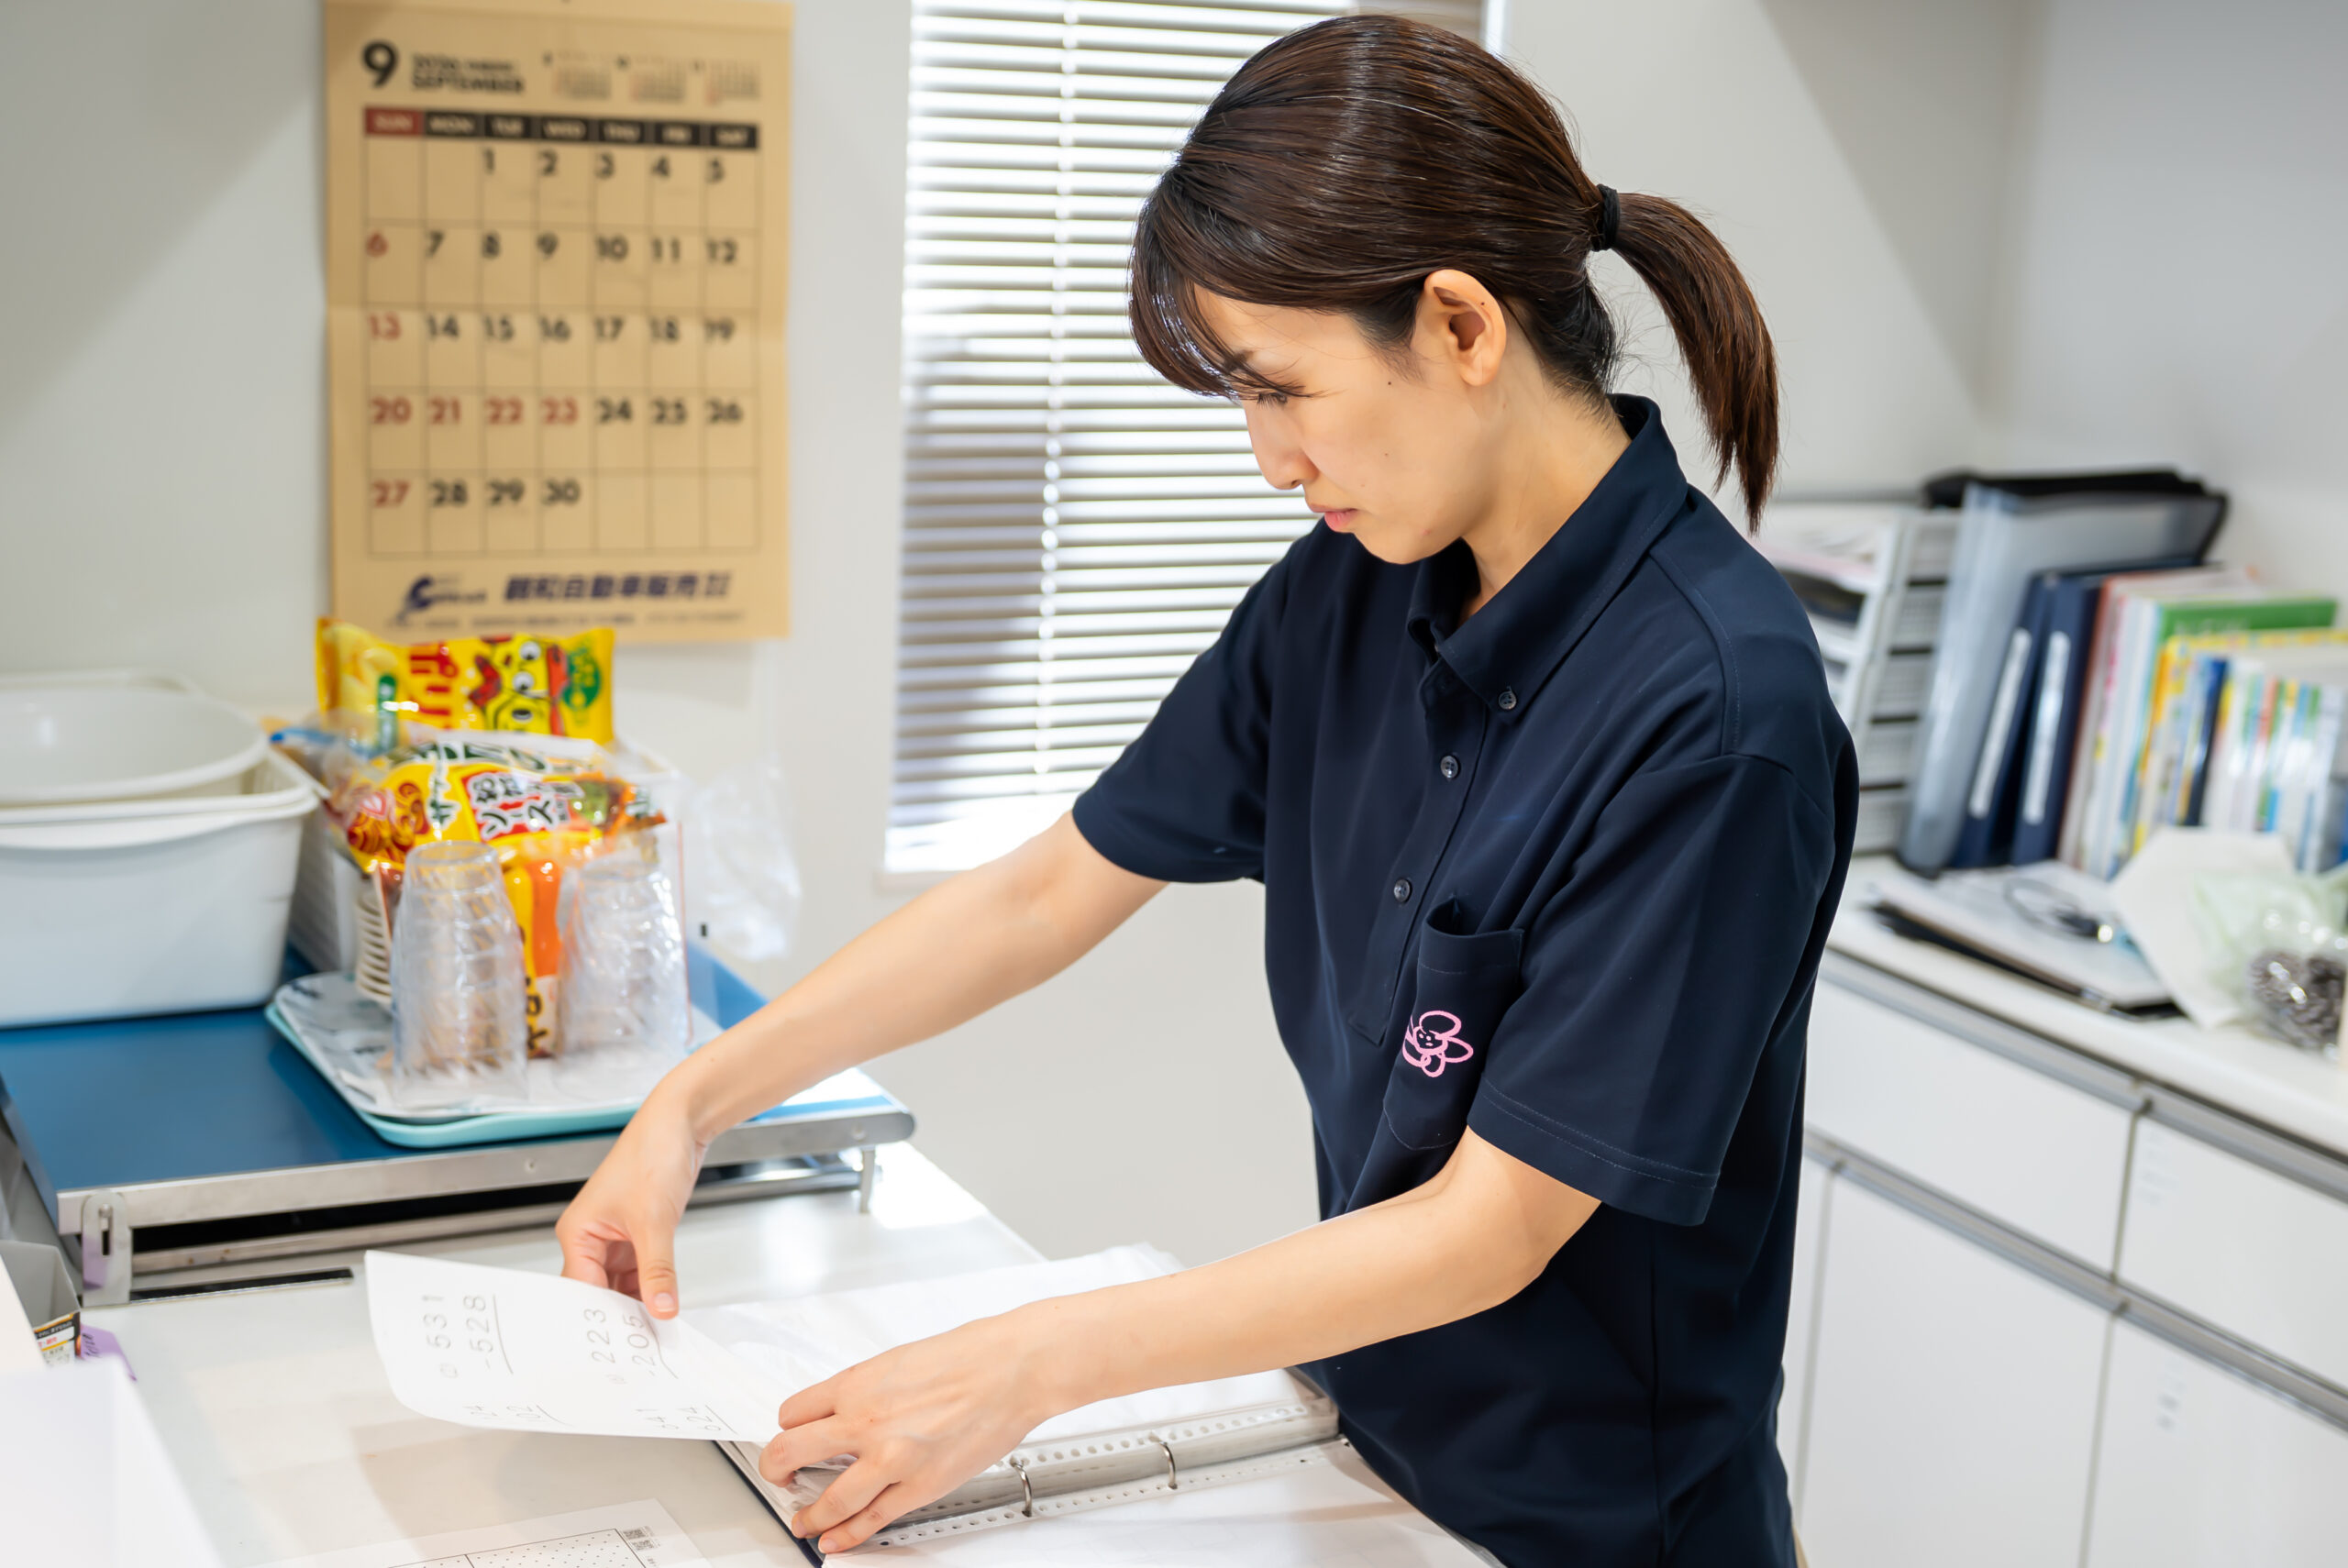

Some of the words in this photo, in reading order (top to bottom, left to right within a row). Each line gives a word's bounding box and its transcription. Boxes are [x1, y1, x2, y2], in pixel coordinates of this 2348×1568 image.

[361, 40, 399, 88] 9
[413, 72, 526, 94] SEPTEMBER
[373, 113, 413, 130] SUN
[429, 115, 474, 133] MON
[544, 119, 586, 138] WED
[482, 147, 496, 175] 1
[537, 149, 559, 177] 2
[595, 153, 615, 181] 3
[650, 154, 672, 180] 4
[706, 156, 726, 183] 5
[367, 231, 388, 258] 6
[426, 229, 445, 258] 7
[481, 232, 501, 259] 8
[536, 232, 559, 259] 9
[593, 235, 629, 262] 10
[649, 237, 681, 263] 11
[705, 238, 738, 265] 12
[366, 312, 402, 341] 13
[426, 315, 460, 338] 14
[482, 314, 515, 342] 15
[537, 315, 571, 342] 16
[593, 315, 626, 341] 17
[648, 315, 680, 343] 18
[702, 315, 736, 341] 19
[368, 396, 412, 425] 20
[426, 396, 461, 425] 21
[483, 396, 524, 425] 22
[539, 396, 579, 425] 23
[596, 398, 633, 425] 24
[650, 397, 688, 425] 25
[705, 398, 743, 425] 26
[369, 479, 411, 509] 27
[429, 480, 469, 507] 28
[486, 480, 526, 507] 29
[541, 478, 581, 506] 30
[583, 1308, 616, 1364] 223
